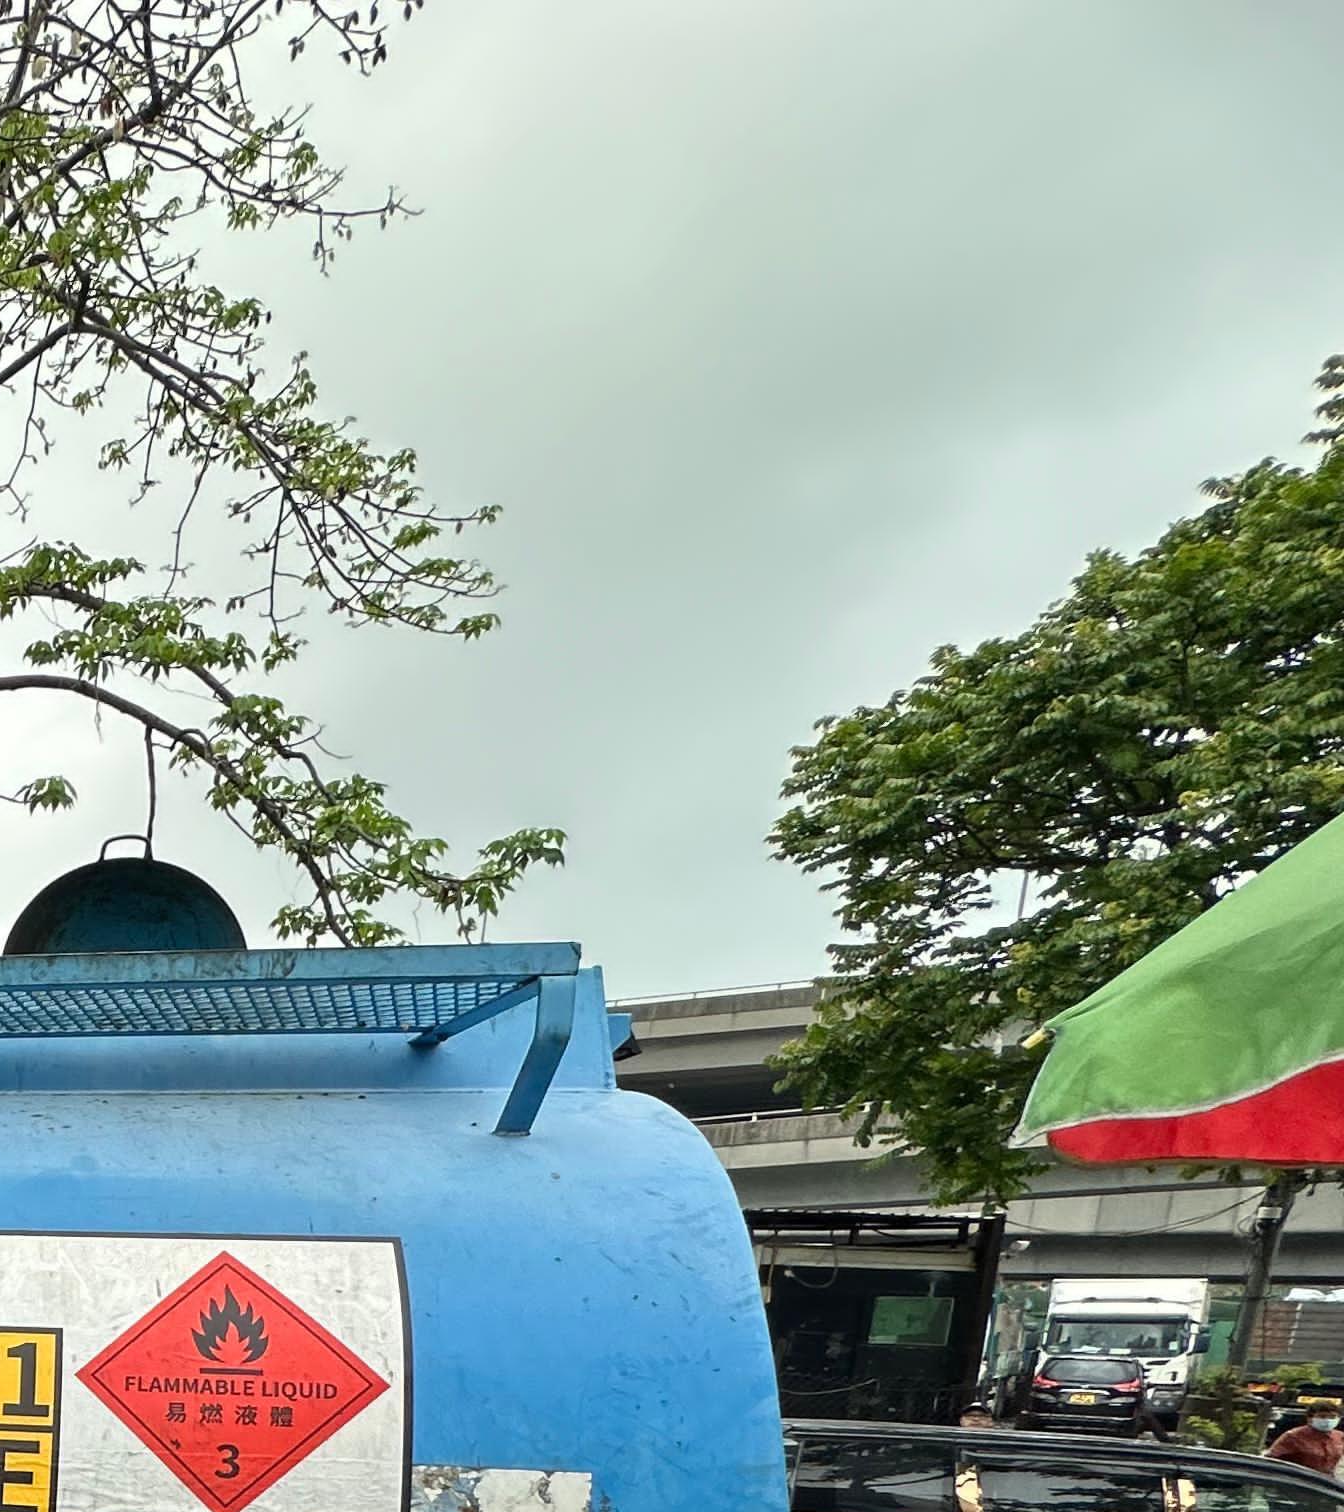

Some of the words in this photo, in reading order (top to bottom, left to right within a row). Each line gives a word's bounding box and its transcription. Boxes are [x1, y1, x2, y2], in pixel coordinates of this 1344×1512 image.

[124, 1376, 255, 1396] FLAMMABLE
[261, 1381, 338, 1402] LIQUID
[166, 1402, 293, 1428] 易燃液體
[214, 1444, 240, 1479] 3
